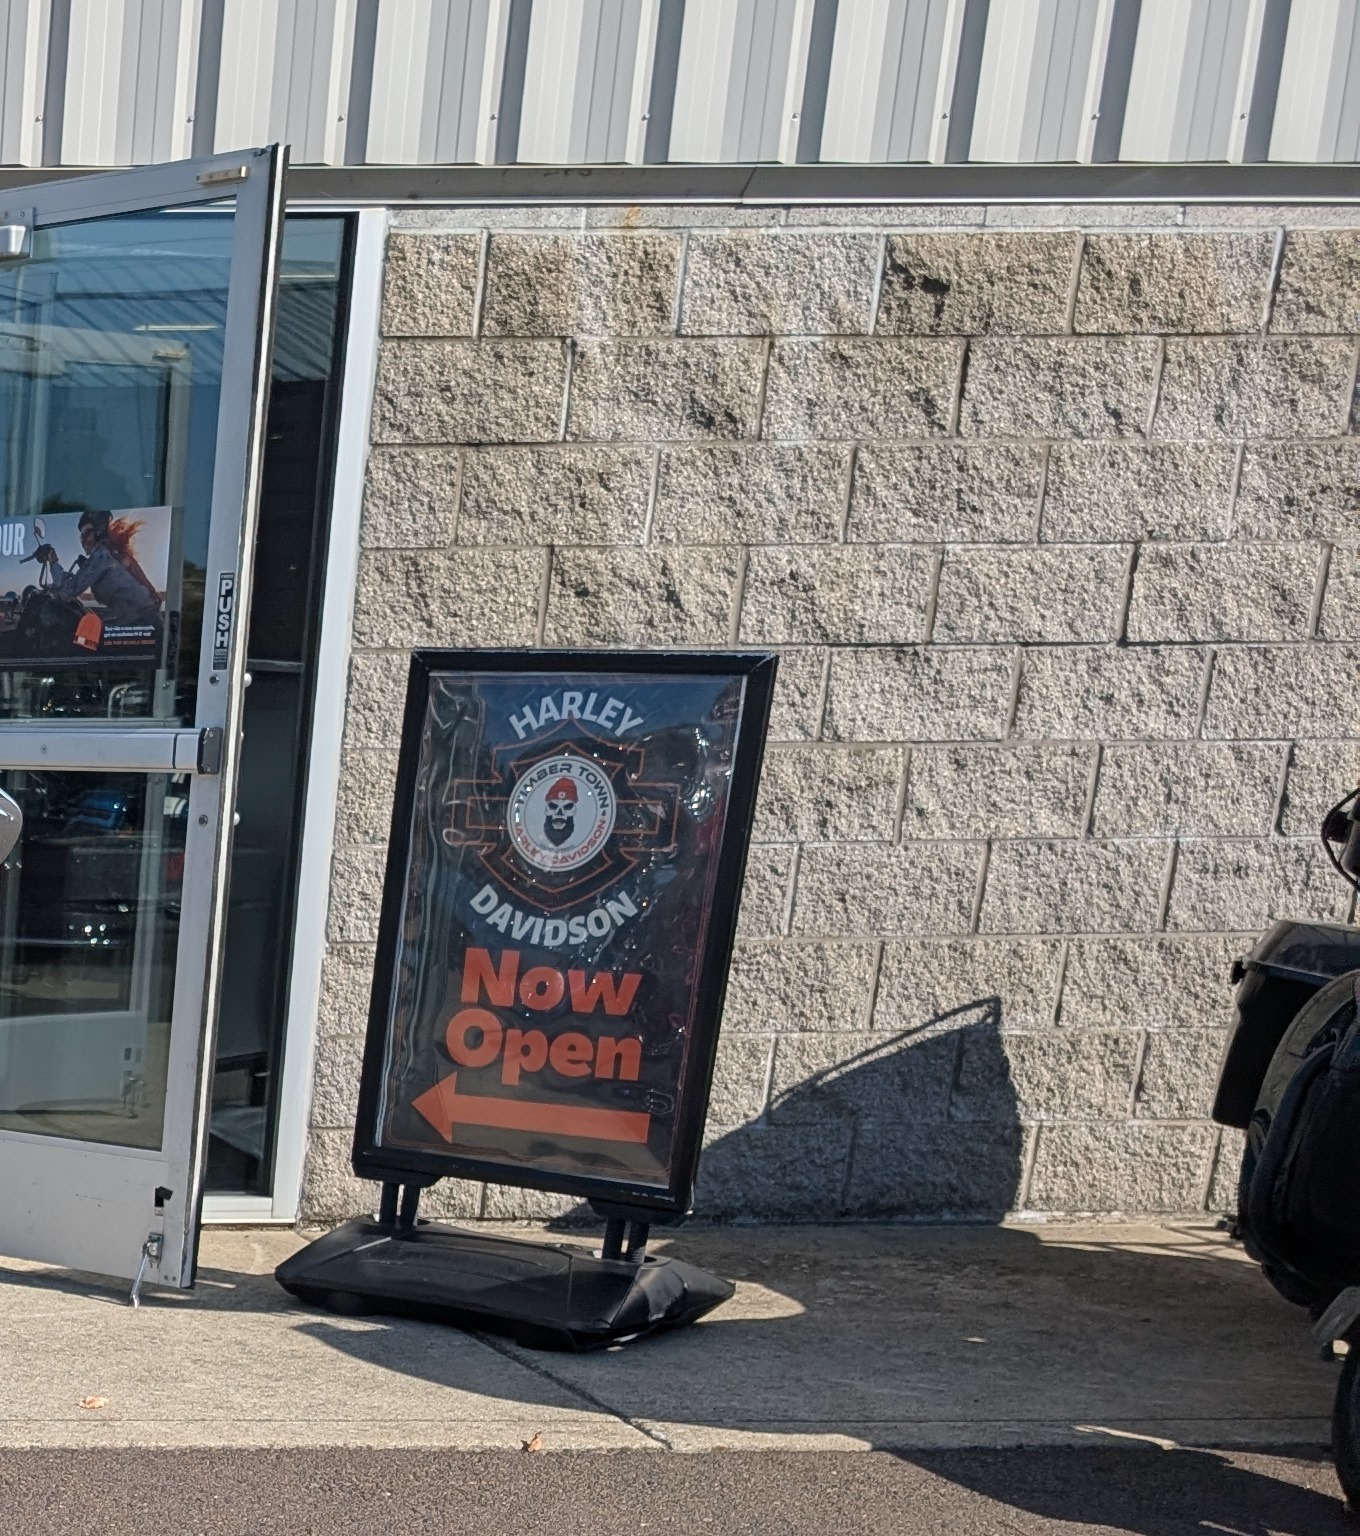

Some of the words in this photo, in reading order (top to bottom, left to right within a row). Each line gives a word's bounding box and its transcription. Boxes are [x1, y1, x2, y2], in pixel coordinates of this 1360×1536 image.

[215, 579, 233, 648] PUSH
[508, 691, 644, 740] HARLEY
[578, 766, 609, 808] TOWN
[469, 884, 638, 946] DAVIDSON
[461, 947, 643, 1016] Now
[446, 1008, 642, 1086] Open
